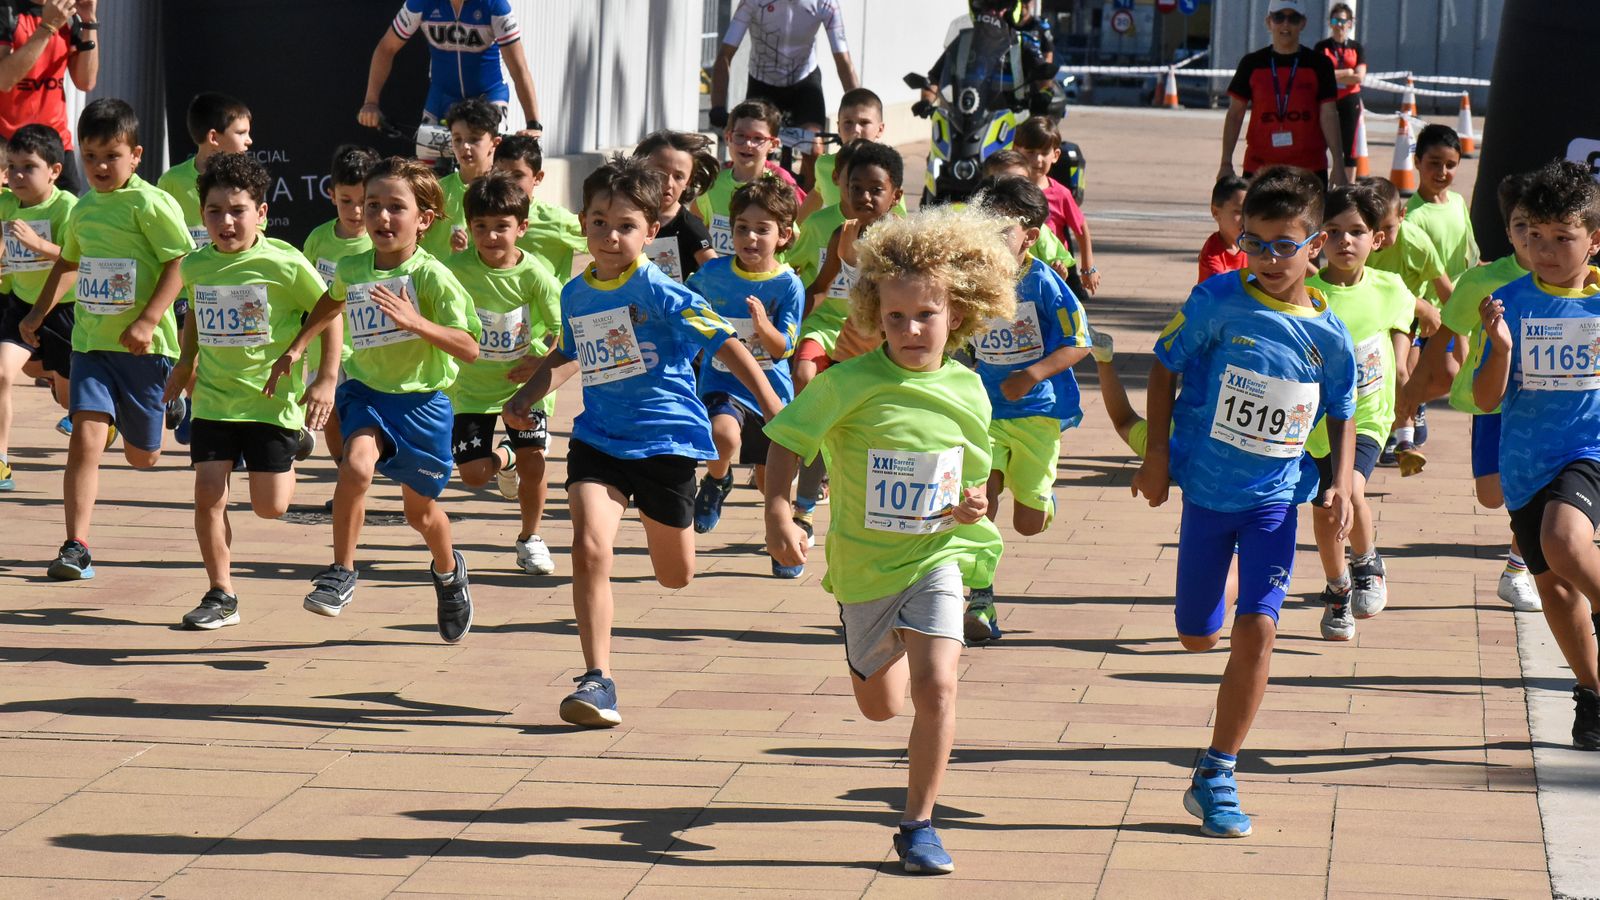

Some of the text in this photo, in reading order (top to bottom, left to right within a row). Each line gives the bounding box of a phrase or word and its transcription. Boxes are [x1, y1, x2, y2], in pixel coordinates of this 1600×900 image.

[428, 24, 485, 47] UCA
[1260, 110, 1312, 123] EVOS
[267, 215, 290, 226] ona
[78, 276, 110, 299] 1044
[198, 306, 240, 331] 1213
[592, 315, 613, 325] MARCO
[480, 328, 511, 349] 038
[1526, 325, 1544, 336] XXI
[1529, 345, 1589, 370] 1165
[1227, 372, 1268, 390] XXI Carrera
[1245, 384, 1266, 395] Popular
[1224, 396, 1286, 435] 1519
[873, 457, 893, 470] XXI
[875, 480, 939, 511] 1077
